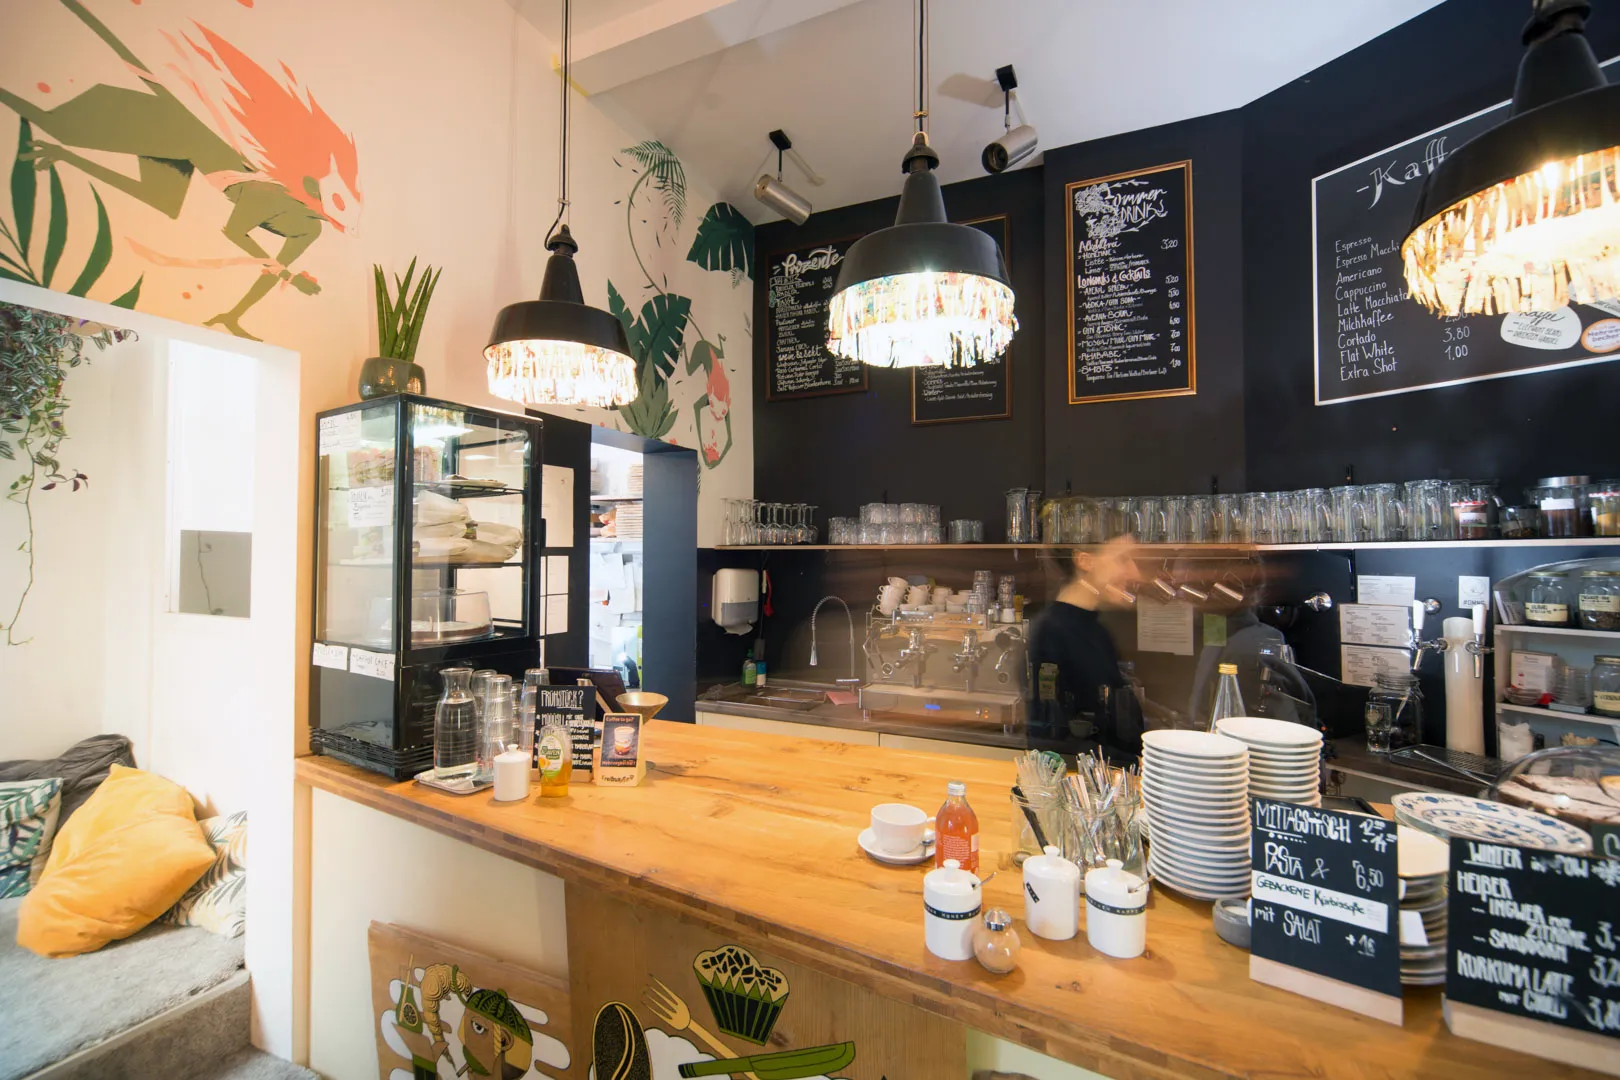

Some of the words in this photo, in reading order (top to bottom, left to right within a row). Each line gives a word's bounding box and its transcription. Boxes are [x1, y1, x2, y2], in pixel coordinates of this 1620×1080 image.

[1336, 237, 1372, 254] Espresso
[1336, 254, 1368, 269] Espresso
[1336, 267, 1382, 285] Americano
[1335, 283, 1387, 302] Cappuccino
[1338, 301, 1361, 317] Latte
[1365, 288, 1409, 309] Macchiato
[1338, 309, 1394, 332] Milchkaffee
[1338, 330, 1376, 348] Cortado
[1341, 350, 1359, 364] Flat
[1362, 341, 1395, 359] White
[1340, 364, 1369, 381] Extra
[1373, 357, 1398, 375] Shot
[1256, 801, 1353, 843] MITTAGSTISCH
[1264, 841, 1304, 880] PASTA
[1468, 842, 1524, 870] WINTER
[1255, 874, 1311, 900] GEBACKENE
[1488, 898, 1546, 925] INGWER
[1255, 905, 1276, 922] mit
[1283, 910, 1322, 944] SALAT
[1456, 949, 1532, 991] KURKUMA
